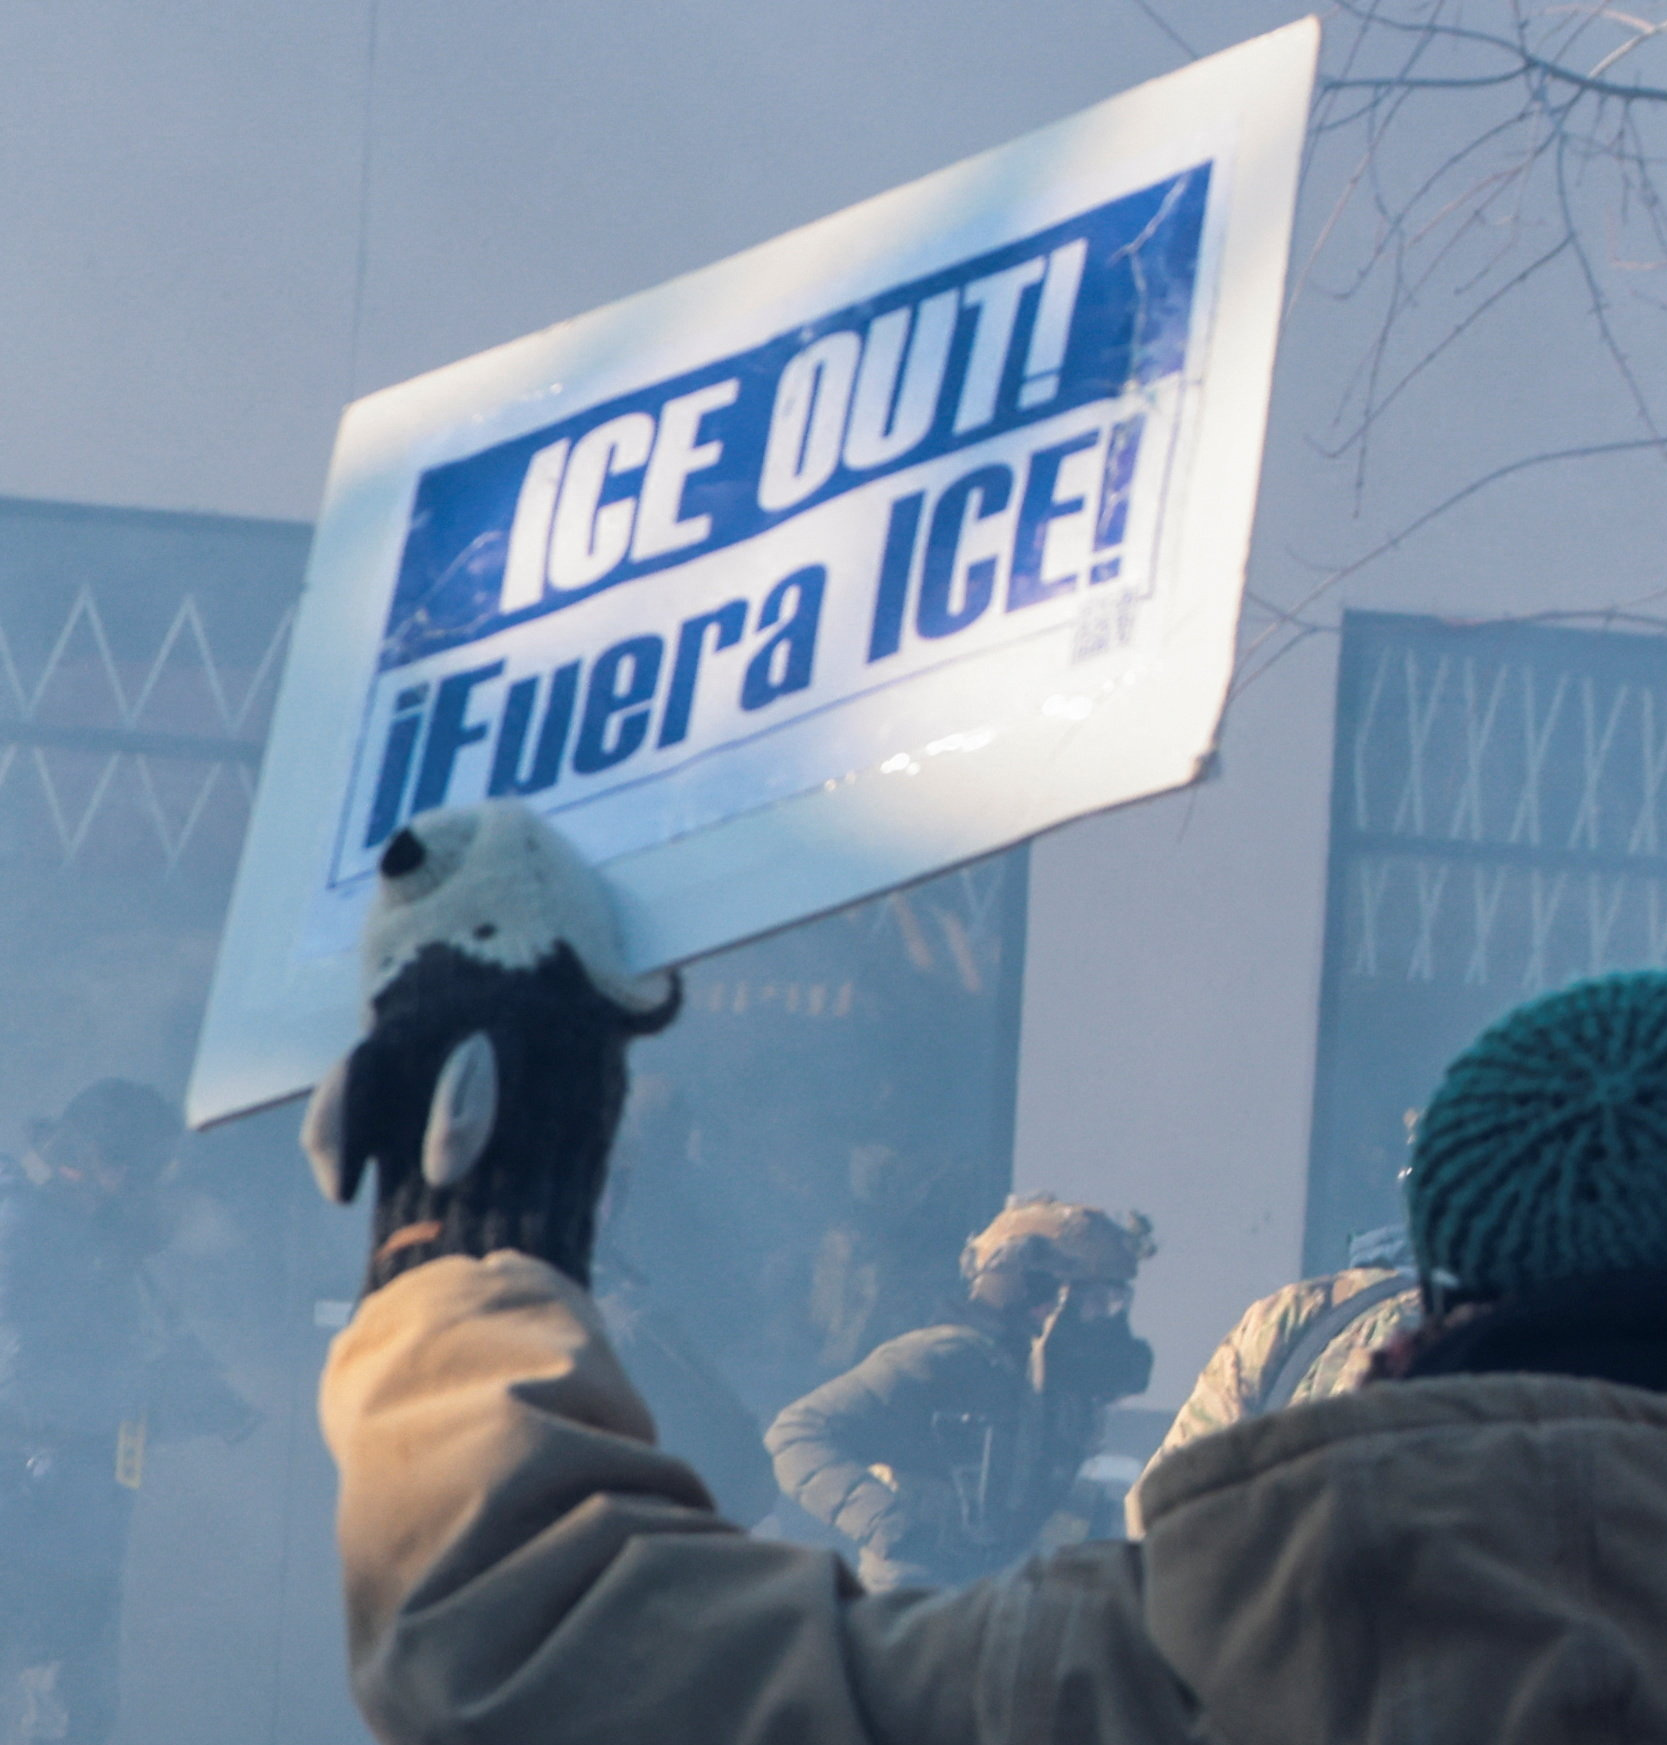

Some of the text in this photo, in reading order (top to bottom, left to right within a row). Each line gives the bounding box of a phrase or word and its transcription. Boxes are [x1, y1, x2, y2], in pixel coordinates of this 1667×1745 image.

[500, 239, 1087, 615] ICE OUT!
[361, 411, 1149, 852] ¡Fuera ICE!
